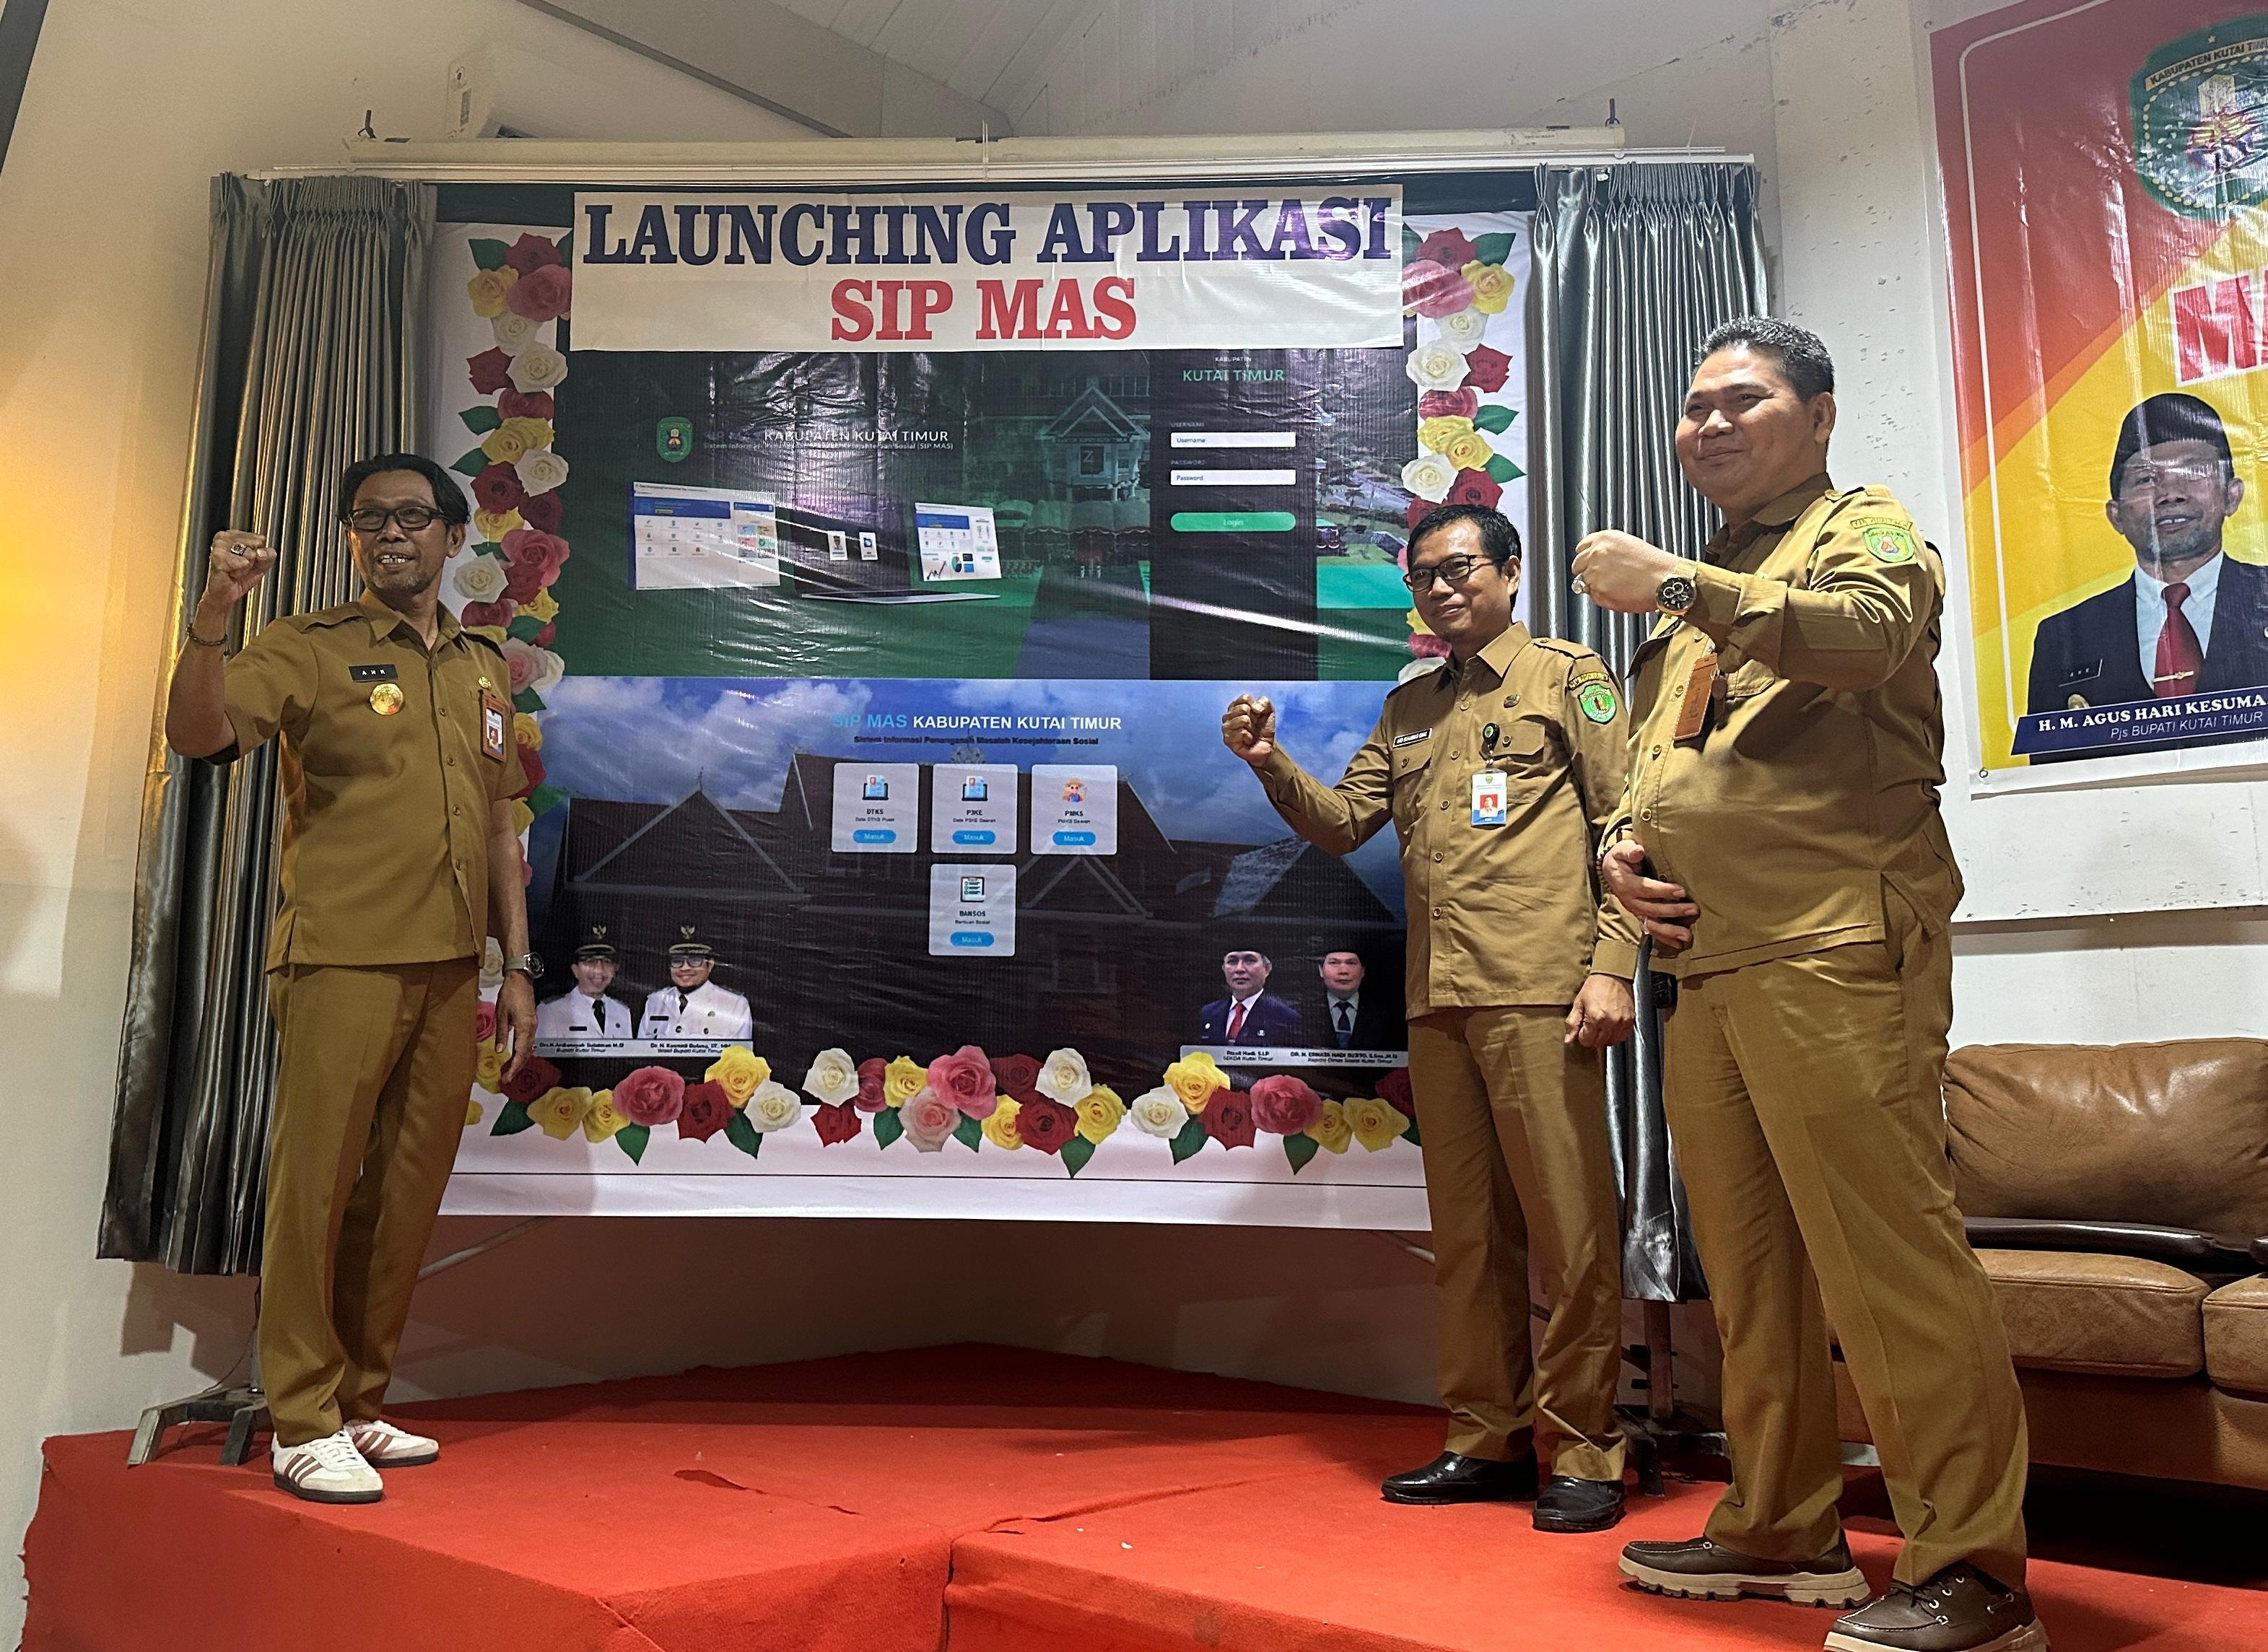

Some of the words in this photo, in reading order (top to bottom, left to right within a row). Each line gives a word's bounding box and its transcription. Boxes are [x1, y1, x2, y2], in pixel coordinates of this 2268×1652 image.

[2150, 53, 2211, 84] KABUPATEN
[2213, 43, 2244, 60] KUTAI
[583, 203, 1016, 266] LAUNCHING
[1037, 196, 1392, 263] APLIKASI
[831, 279, 954, 342] SIP
[976, 276, 1137, 341] MAS
[2170, 268, 2268, 383] M
[1182, 369, 1229, 382] KUTAI
[1234, 368, 1286, 381] TIMUR
[764, 431, 850, 442] KABUPATEN
[855, 431, 899, 442] KUTAI
[902, 431, 948, 442] TIMUR
[832, 714, 861, 727] SIP
[866, 714, 907, 728] MAS
[912, 716, 1012, 729] KABUPATEN
[1016, 717, 1065, 729] KUTAI
[1071, 717, 1122, 730] TIMUR
[2038, 719, 2056, 732] H.
[2059, 716, 2078, 729] M.
[2082, 709, 2131, 727] AGUS
[2134, 704, 2181, 721] HARI
[2110, 727, 2129, 740] Pjs
[2132, 722, 2176, 736] BUPATI
[2179, 717, 2217, 731] KUTAI
[2222, 711, 2264, 726] TIMUR
